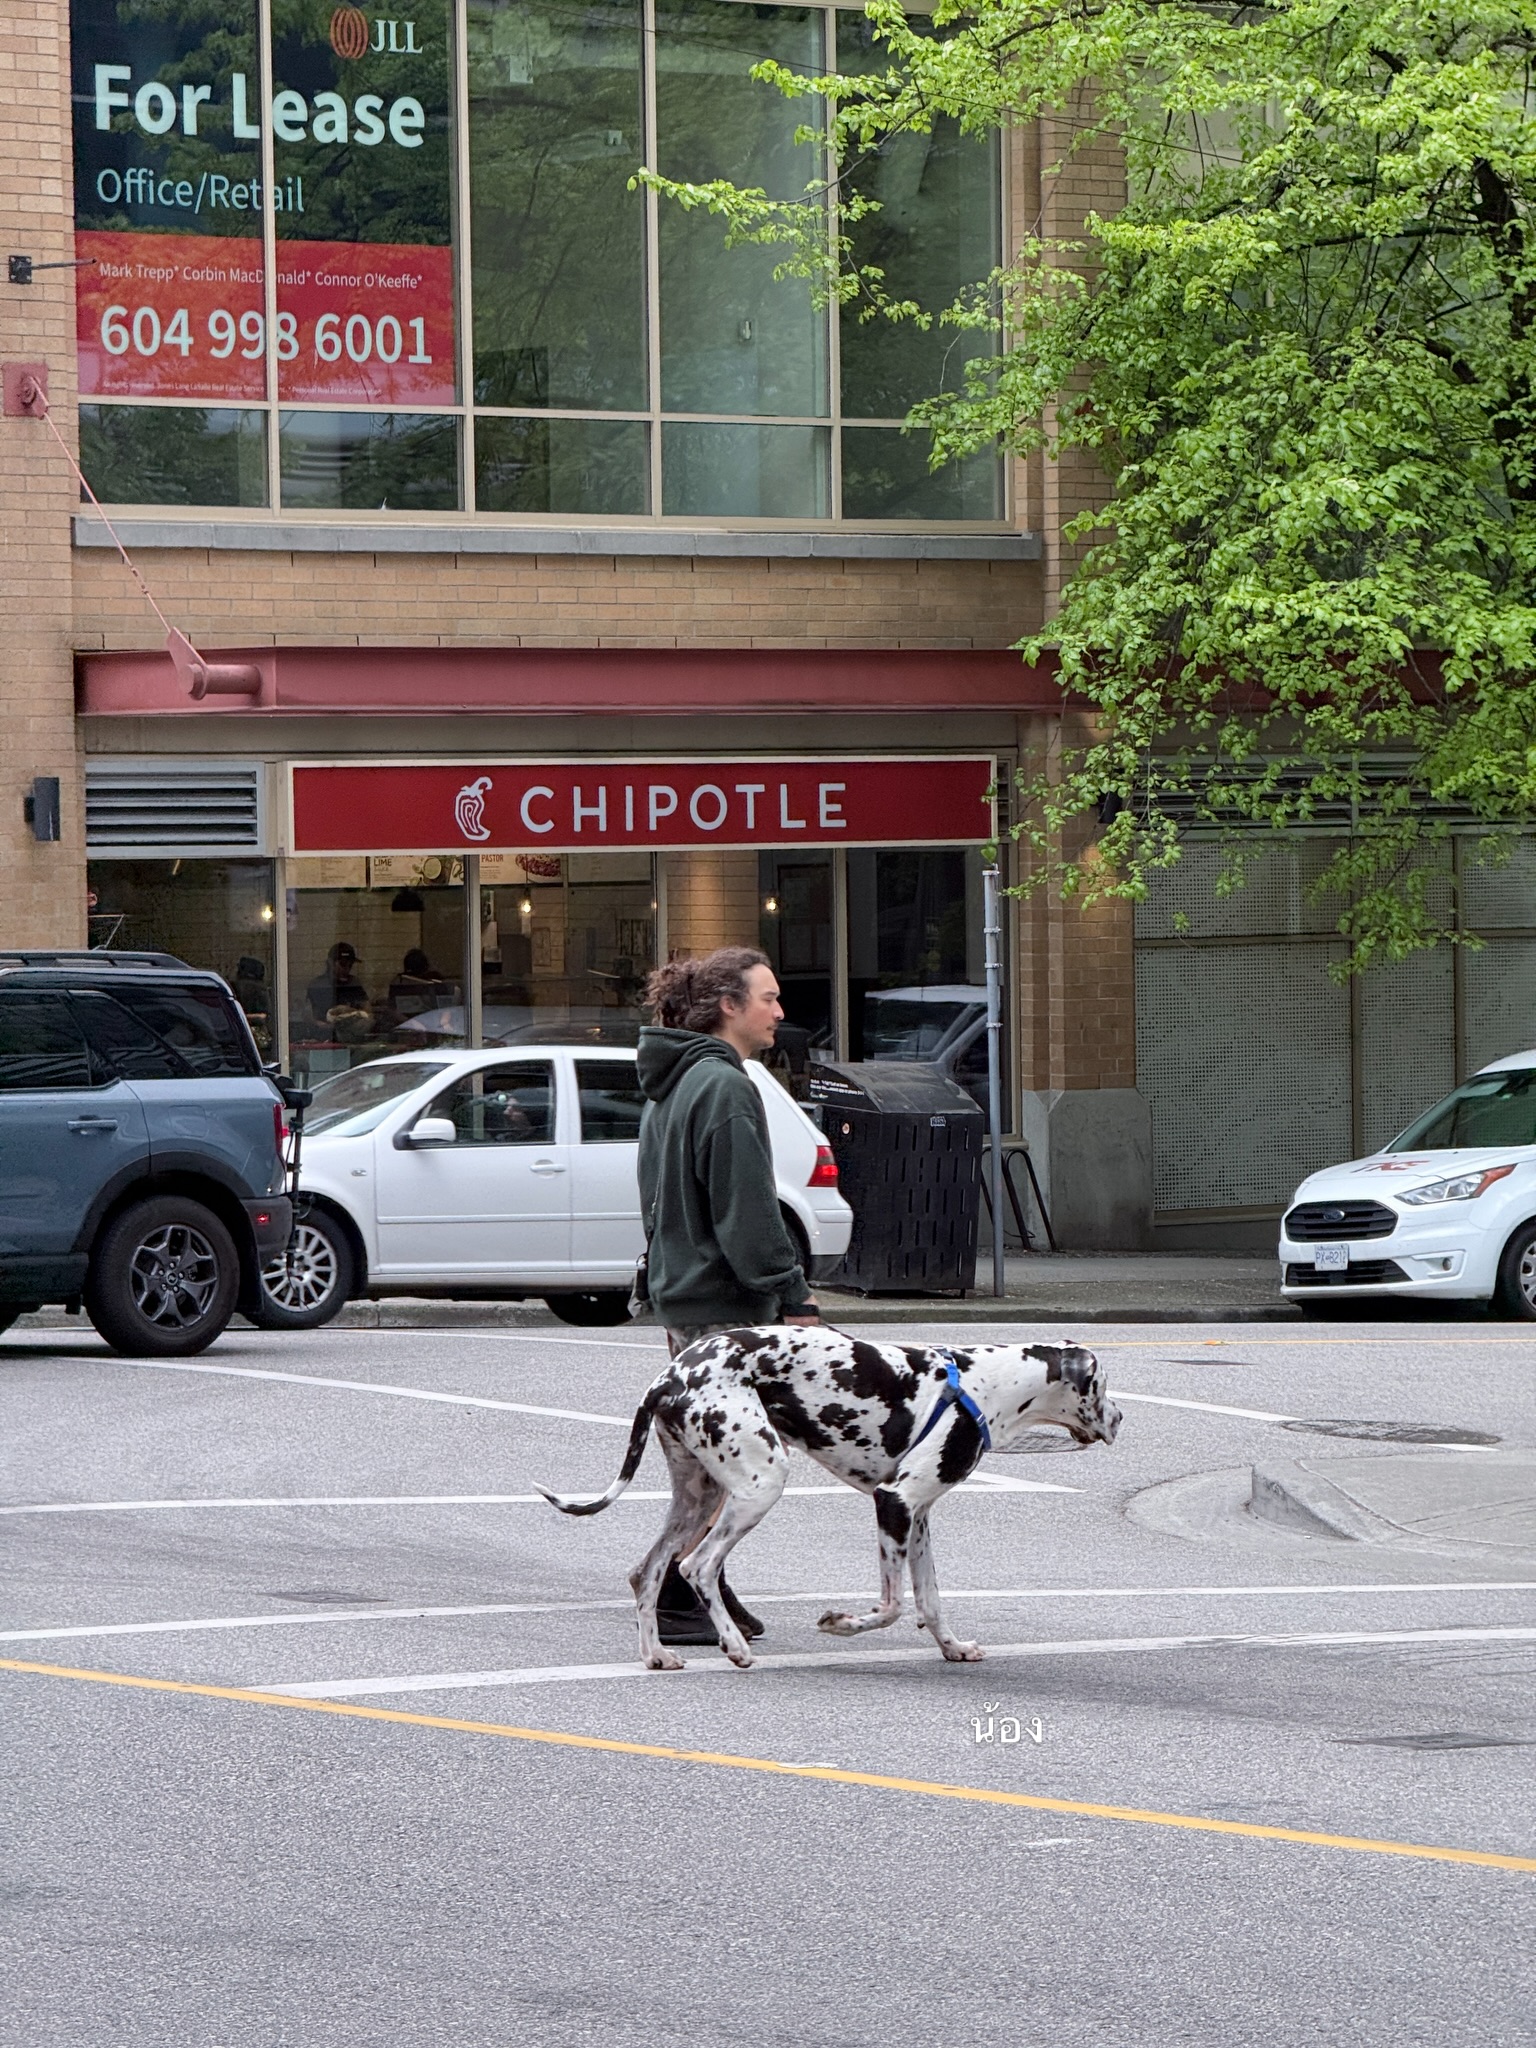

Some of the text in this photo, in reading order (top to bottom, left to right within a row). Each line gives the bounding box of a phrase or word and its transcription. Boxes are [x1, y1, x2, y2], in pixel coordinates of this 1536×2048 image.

[371, 19, 423, 54] JLL
[94, 64, 425, 149] For Lease
[96, 168, 305, 215] Office/Retail
[99, 263, 133, 278] Mark
[183, 266, 227, 282] Corbin
[229, 268, 312, 285] MacDnald
[315, 271, 362, 287] Connor
[101, 304, 433, 365] 604 998 6001
[520, 781, 847, 834] CHIPOTLE
[373, 858, 392, 867] LIME
[481, 854, 504, 863] PASTOR
